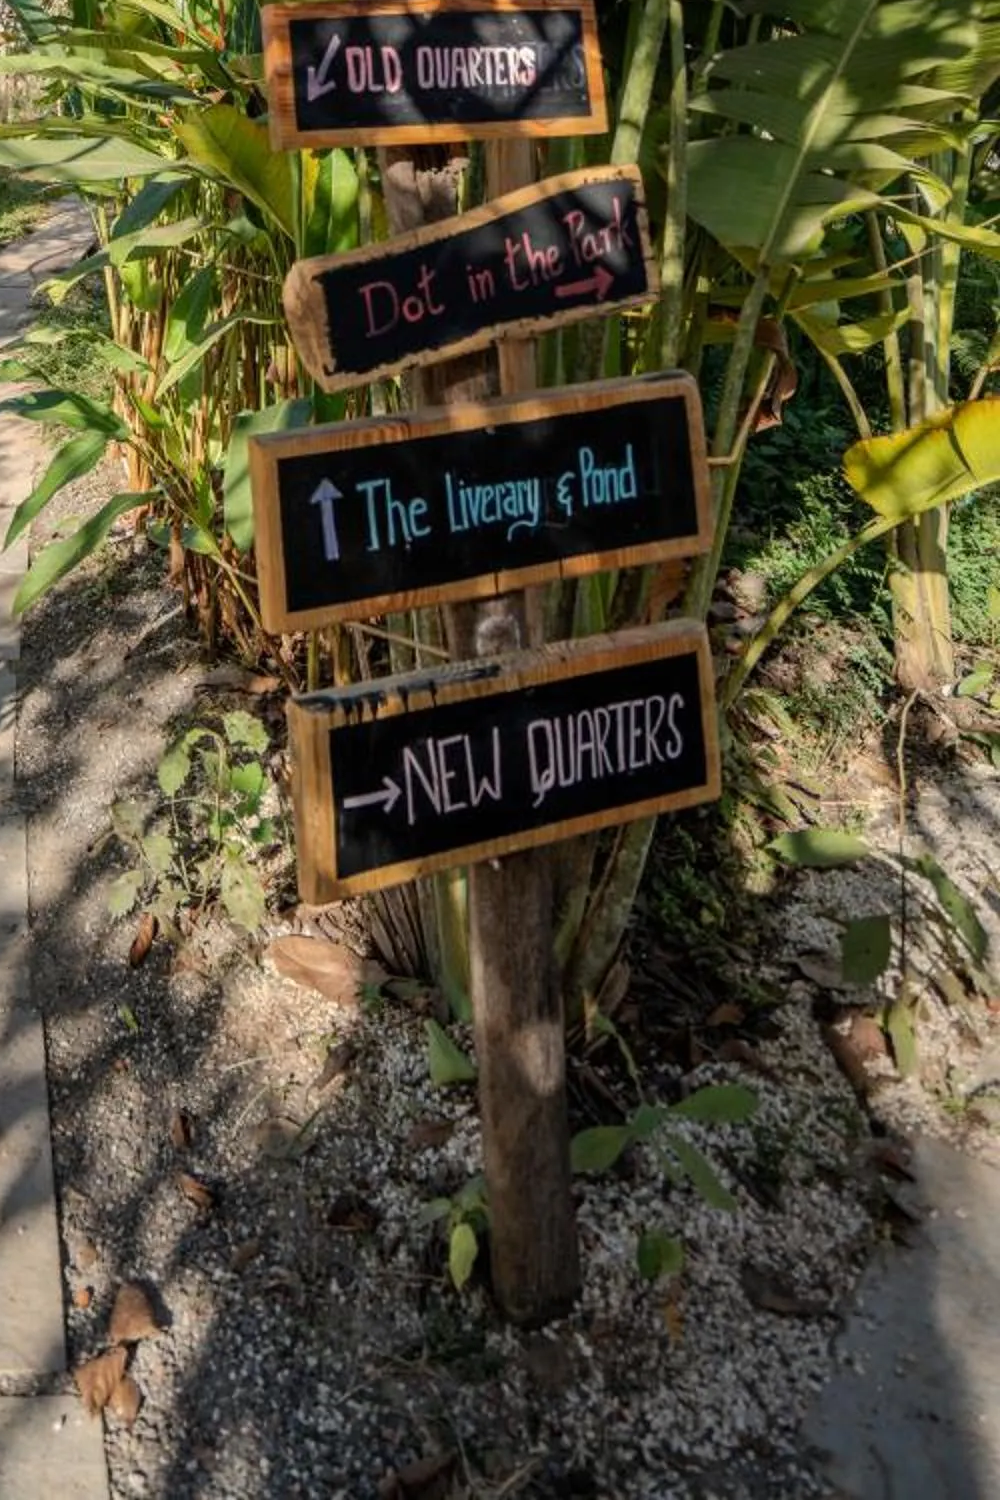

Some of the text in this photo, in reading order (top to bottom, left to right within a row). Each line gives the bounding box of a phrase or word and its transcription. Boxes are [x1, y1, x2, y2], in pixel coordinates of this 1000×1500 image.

[345, 45, 402, 93] OLD
[359, 196, 633, 338] Dot in the Park
[356, 443, 637, 552] The Liverary & Pond
[403, 692, 684, 825] NEW QUARTERS
